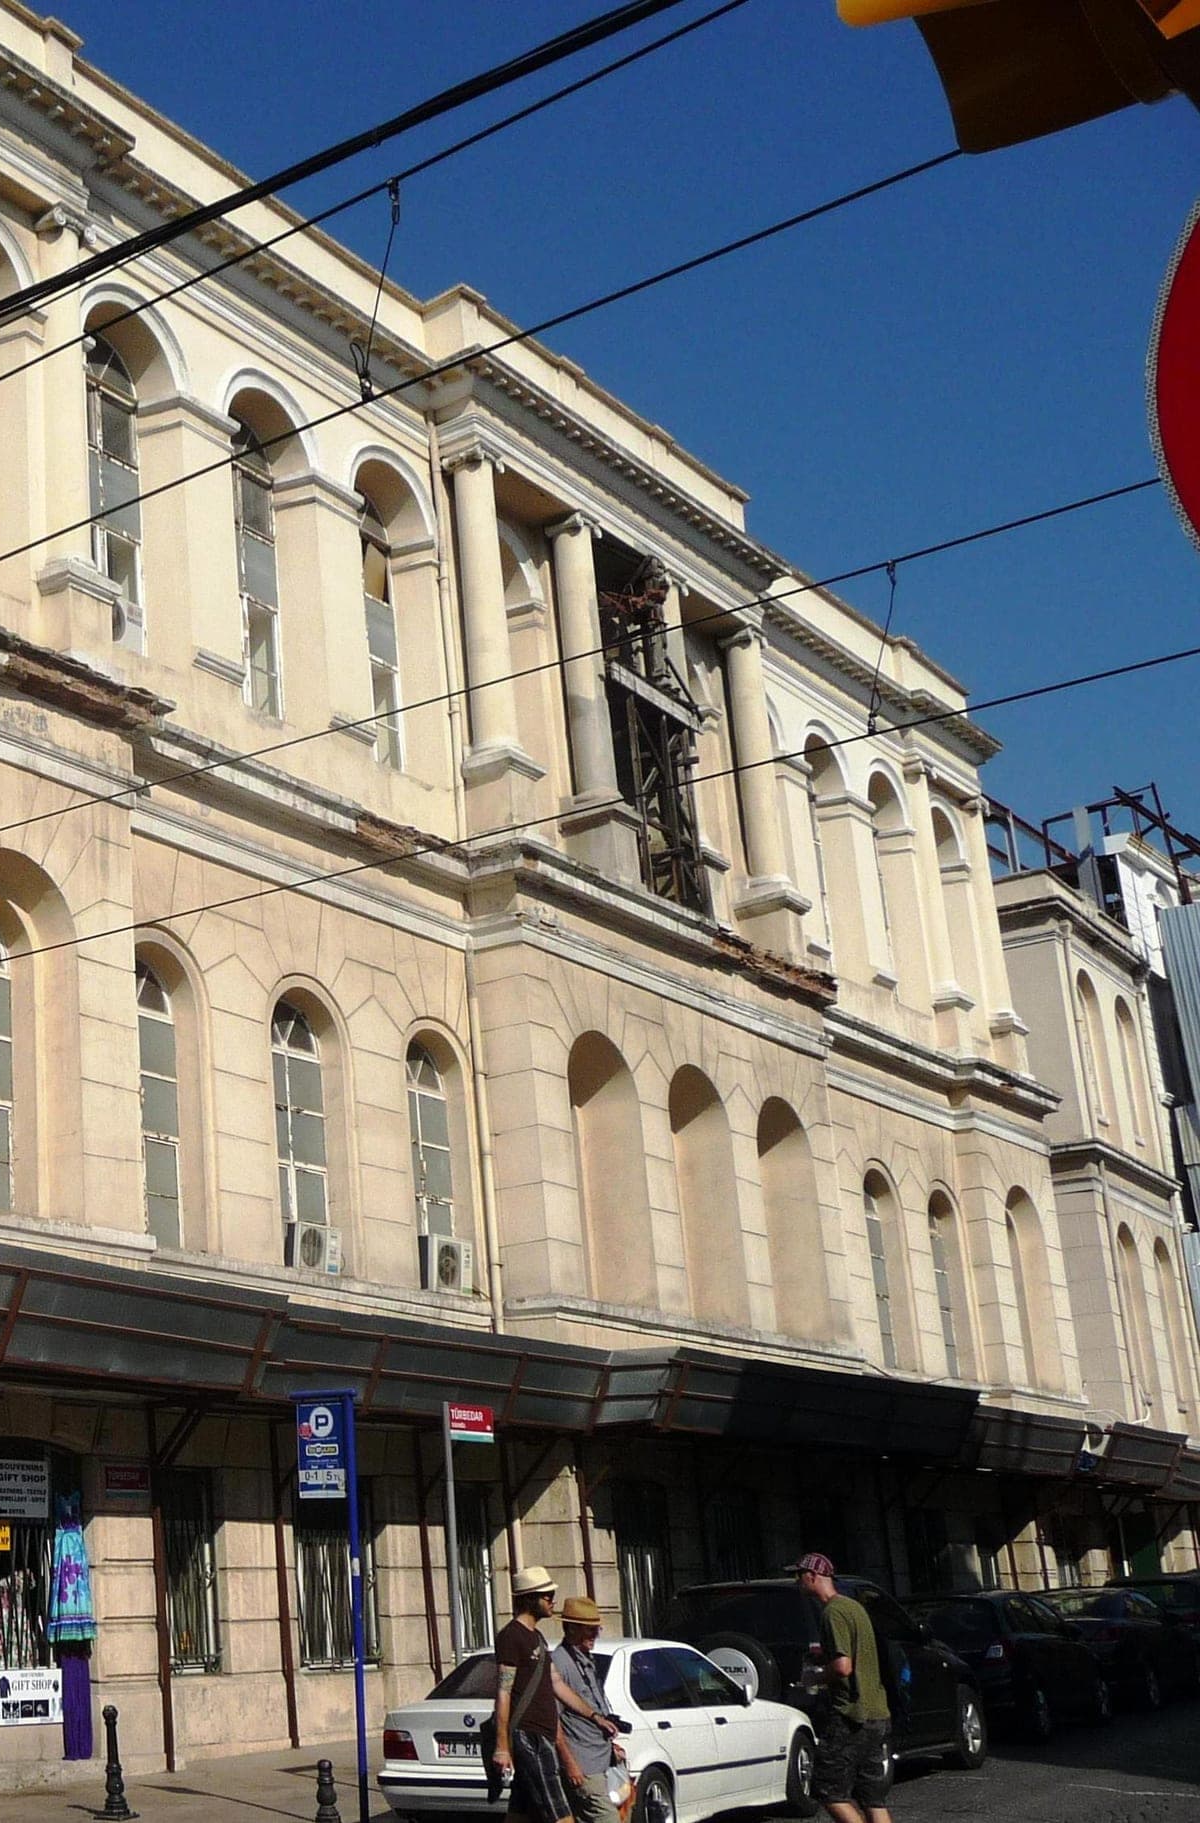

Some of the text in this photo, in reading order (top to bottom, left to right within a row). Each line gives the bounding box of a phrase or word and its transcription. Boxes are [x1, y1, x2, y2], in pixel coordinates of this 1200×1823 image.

[451, 1407, 483, 1421] TÜRBEDAR
[315, 1415, 328, 1430] P
[21, 1473, 46, 1483] SHOP
[721, 1665, 748, 1674] ZUKI
[11, 1679, 51, 1691] GIFT SHOP
